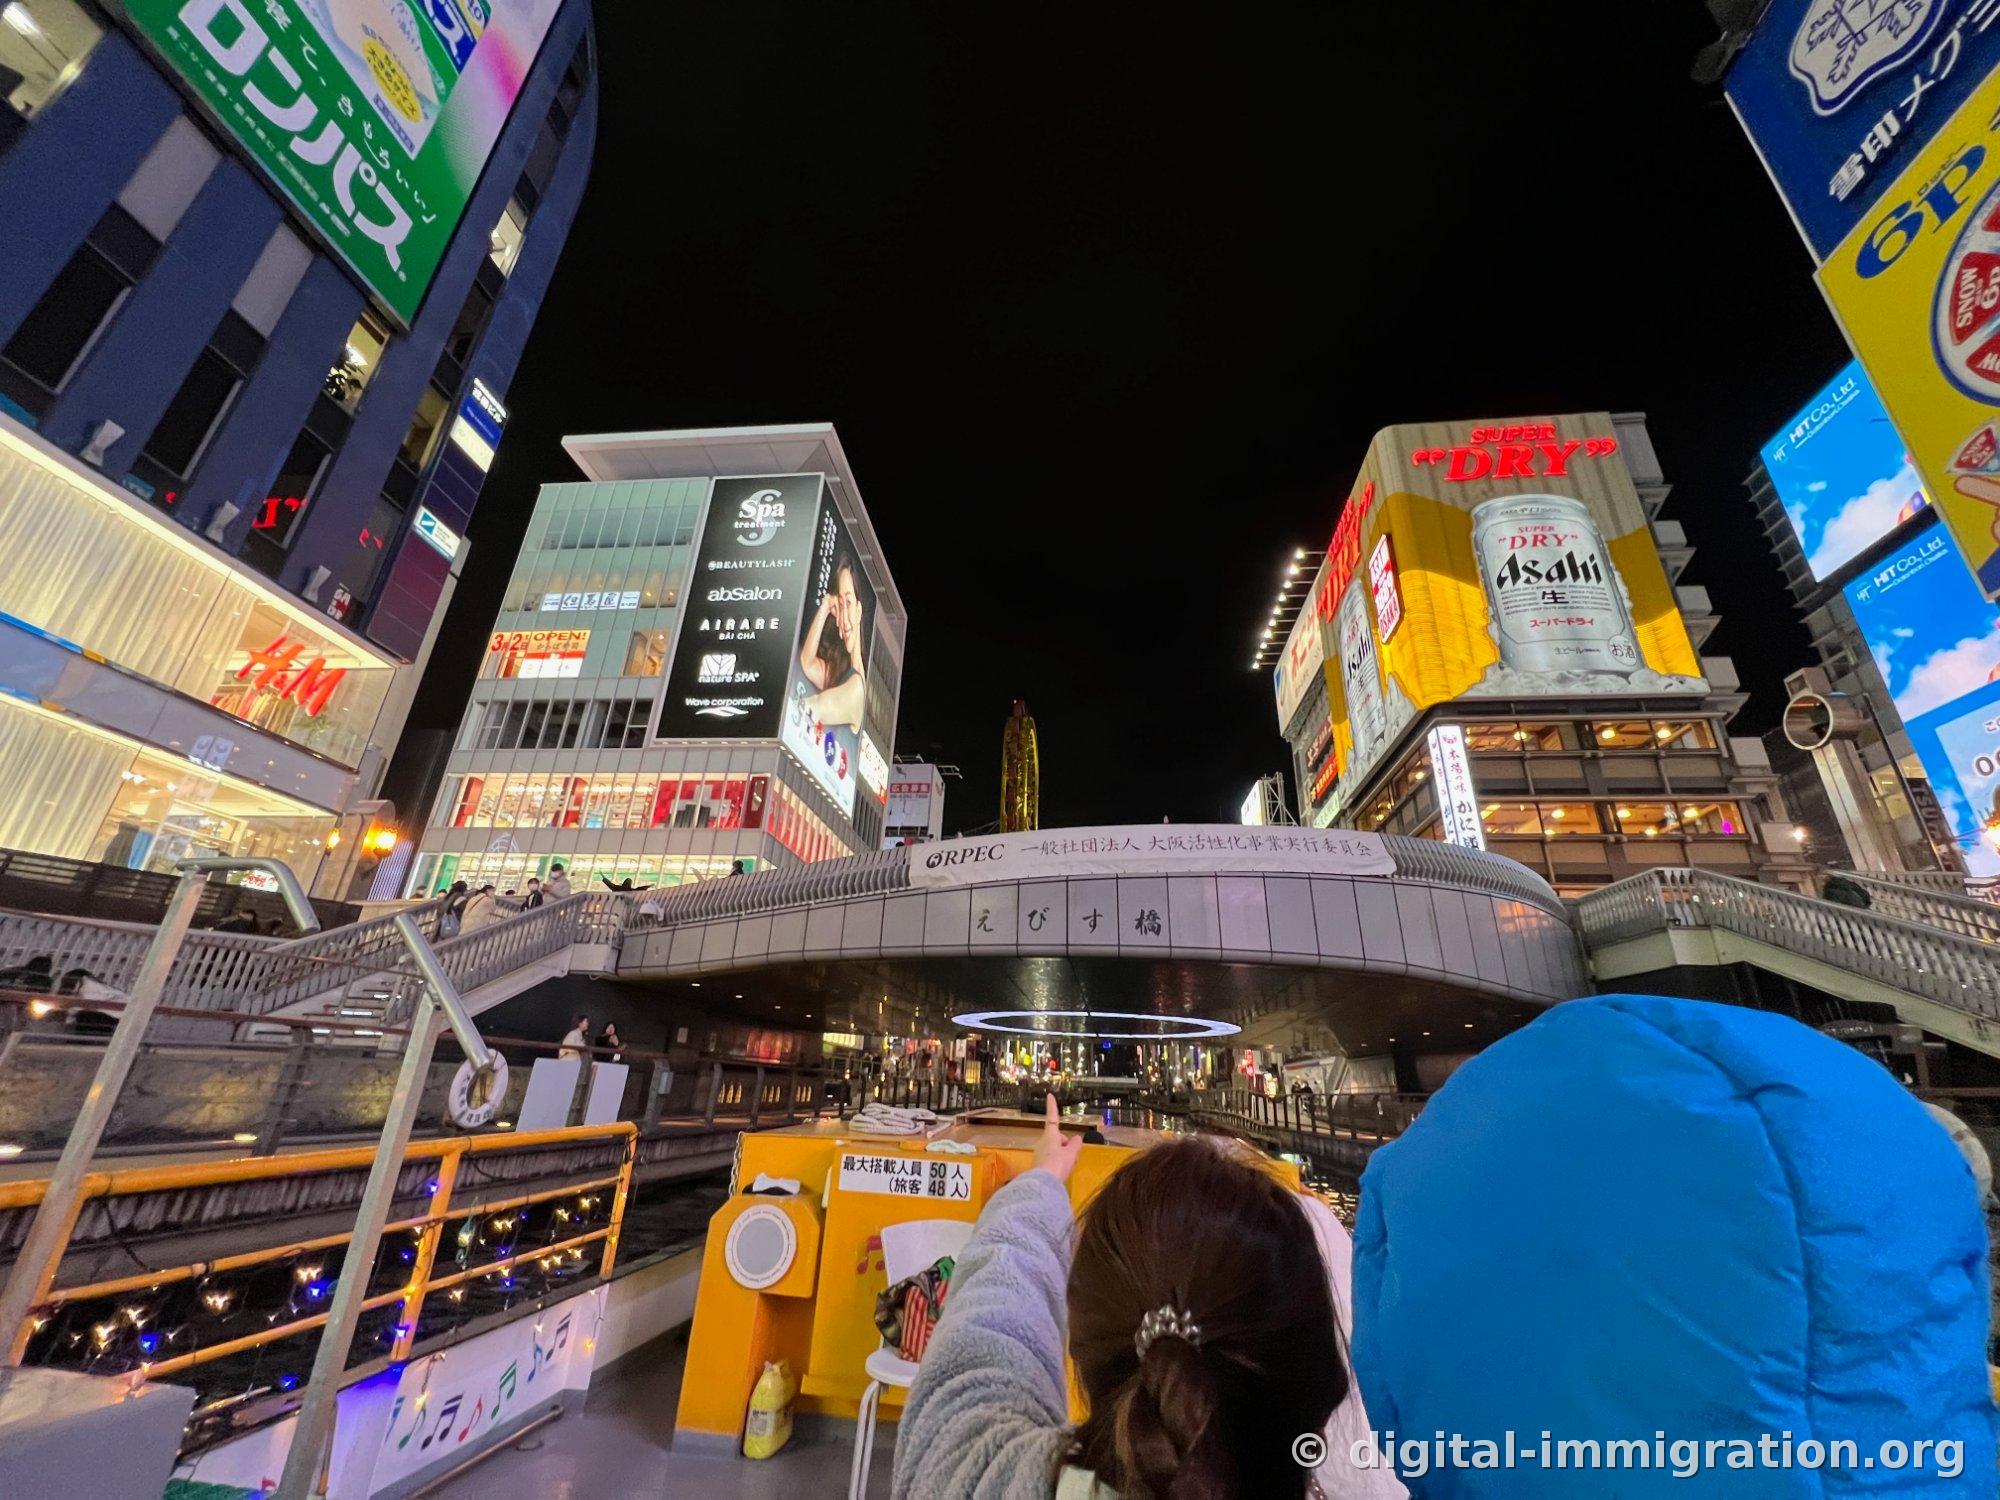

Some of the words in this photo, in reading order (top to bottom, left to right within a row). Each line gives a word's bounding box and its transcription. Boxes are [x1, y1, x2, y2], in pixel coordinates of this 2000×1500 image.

[1855, 144, 1987, 279] 6P
[1956, 267, 1978, 328] SNOW
[1470, 423, 1557, 445] SUPER
[1789, 415, 1811, 443] HIT
[739, 499, 786, 523] Spa
[734, 520, 786, 529] treatment
[1518, 525, 1556, 533] SUPER
[716, 560, 793, 570] BEAUTYLASH
[1496, 550, 1602, 590] Asahi
[1873, 567, 1897, 587] HIT
[707, 586, 783, 602] abSalon
[1541, 590, 1569, 605] 生
[699, 618, 779, 631] AIRARE
[1529, 617, 1595, 628] スーパードライ
[533, 632, 587, 641] OPEN!
[1610, 643, 1636, 659] お酒
[234, 634, 347, 717] H&M
[698, 674, 732, 684] nature
[685, 698, 710, 706] Wave
[711, 697, 764, 707] corporation
[926, 843, 1005, 869] ORPEC
[1021, 836, 1140, 856] 一般社団法人
[1148, 834, 1372, 857] 大阪活性化事業実行委員会
[977, 907, 1163, 937] えびす橋
[843, 1156, 922, 1177] 最大搭載人員
[930, 1162, 946, 1178] 50
[951, 1164, 964, 1180] 人
[889, 1178, 922, 1195] (旅客
[928, 1180, 946, 1197] 48
[950, 1182, 969, 1199] 人)
